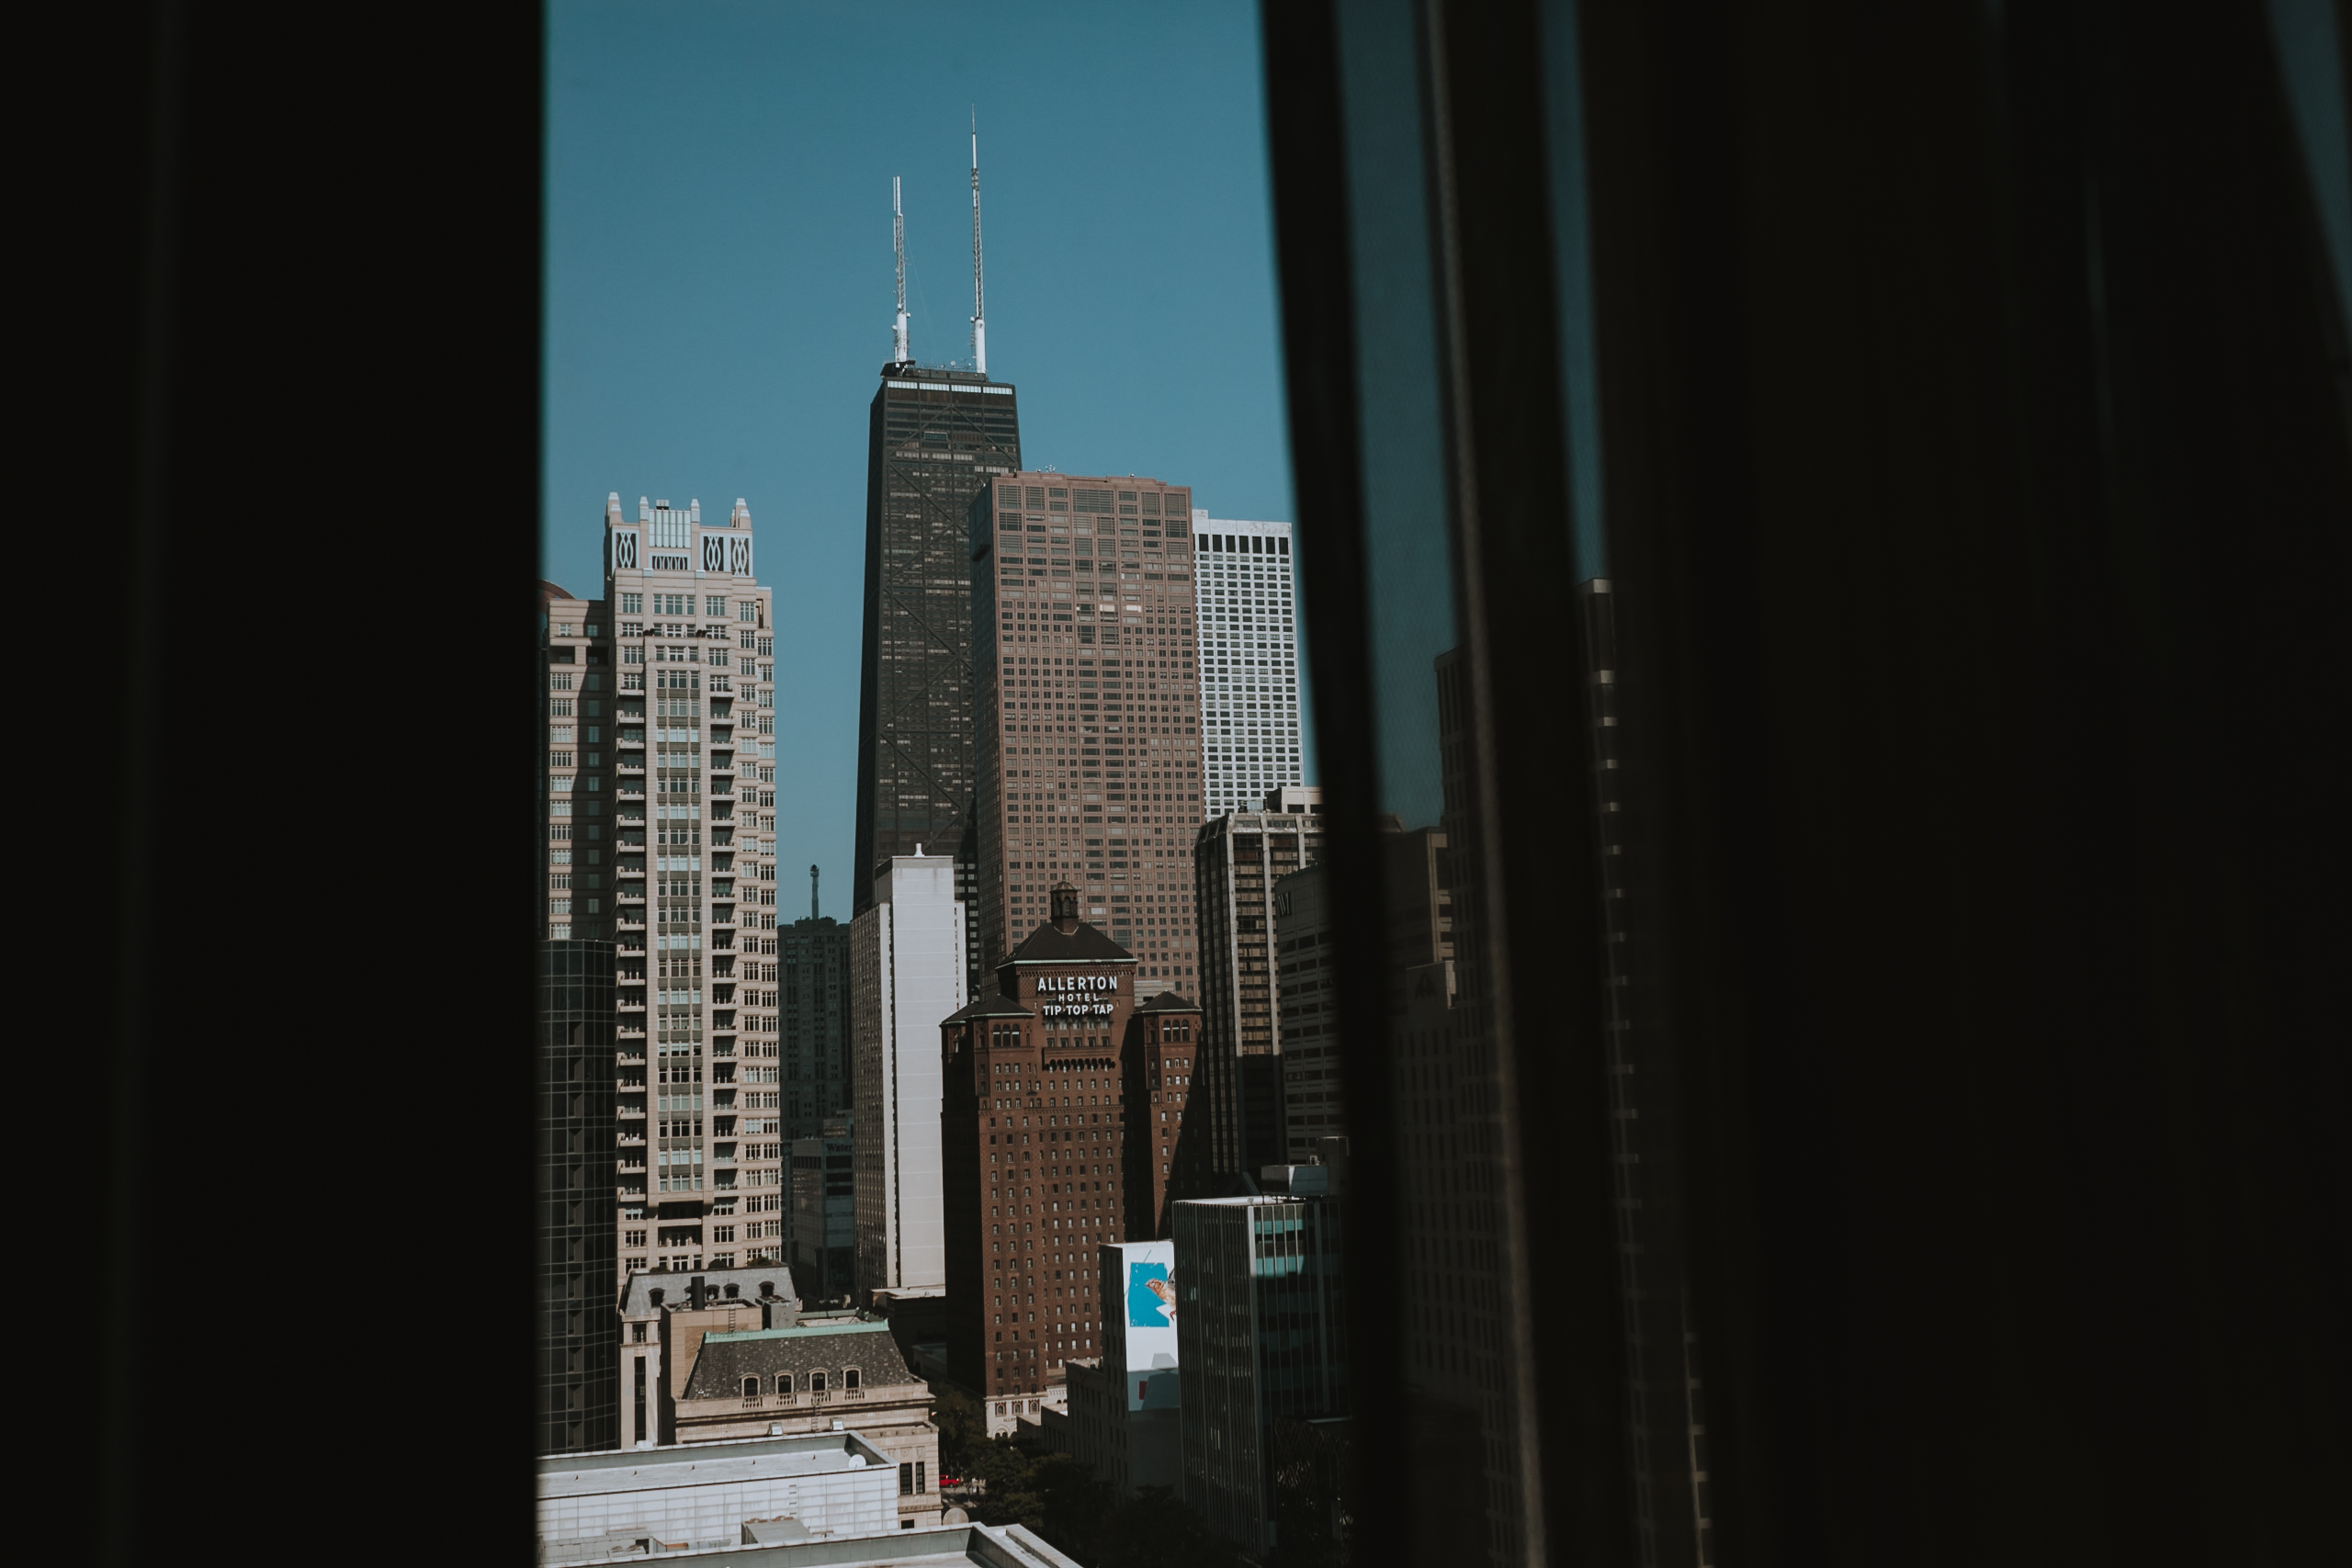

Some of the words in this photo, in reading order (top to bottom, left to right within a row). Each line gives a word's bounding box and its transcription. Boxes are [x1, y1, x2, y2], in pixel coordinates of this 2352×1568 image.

[1037, 976, 1117, 991] ALLERTON
[1058, 993, 1099, 1002] HOTEL
[1043, 1005, 1062, 1016] TIP
[1066, 1005, 1089, 1015] TOP
[1092, 1004, 1114, 1014] TAP
[826, 1144, 853, 1152] Water
